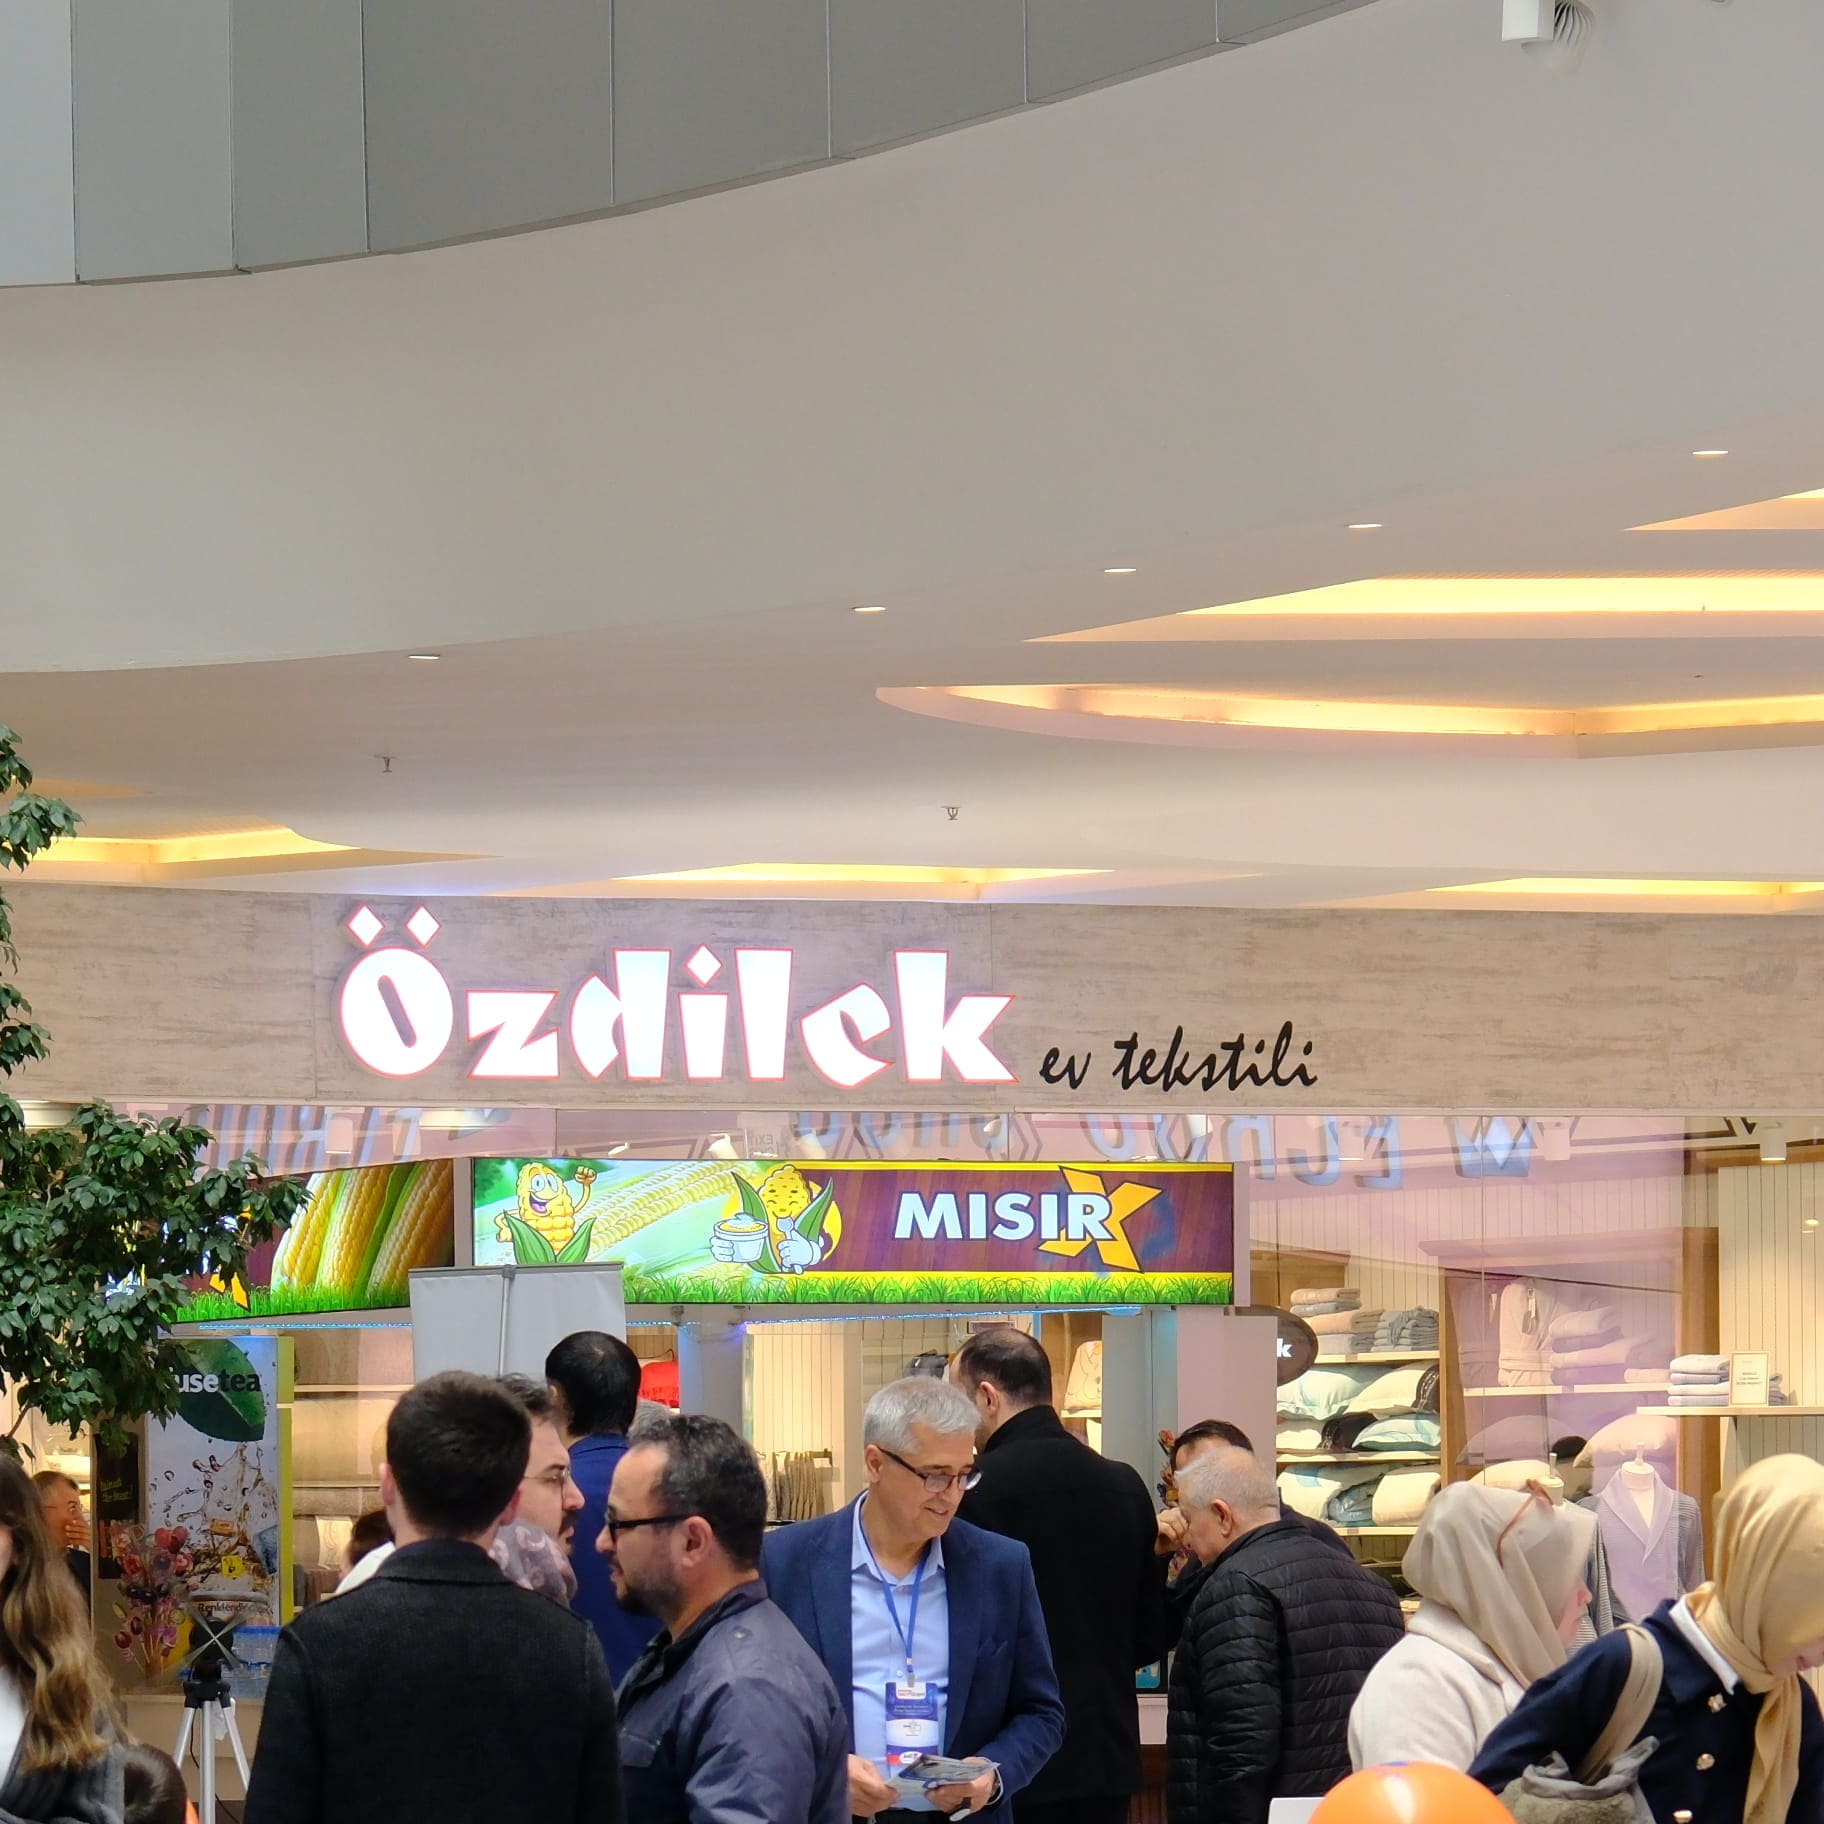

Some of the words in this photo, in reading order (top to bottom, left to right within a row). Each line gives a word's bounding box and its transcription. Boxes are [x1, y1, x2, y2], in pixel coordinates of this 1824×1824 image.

[340, 904, 1019, 1087] Özdilek
[1039, 1047, 1091, 1089] ev
[1112, 1020, 1318, 1092] tekstili
